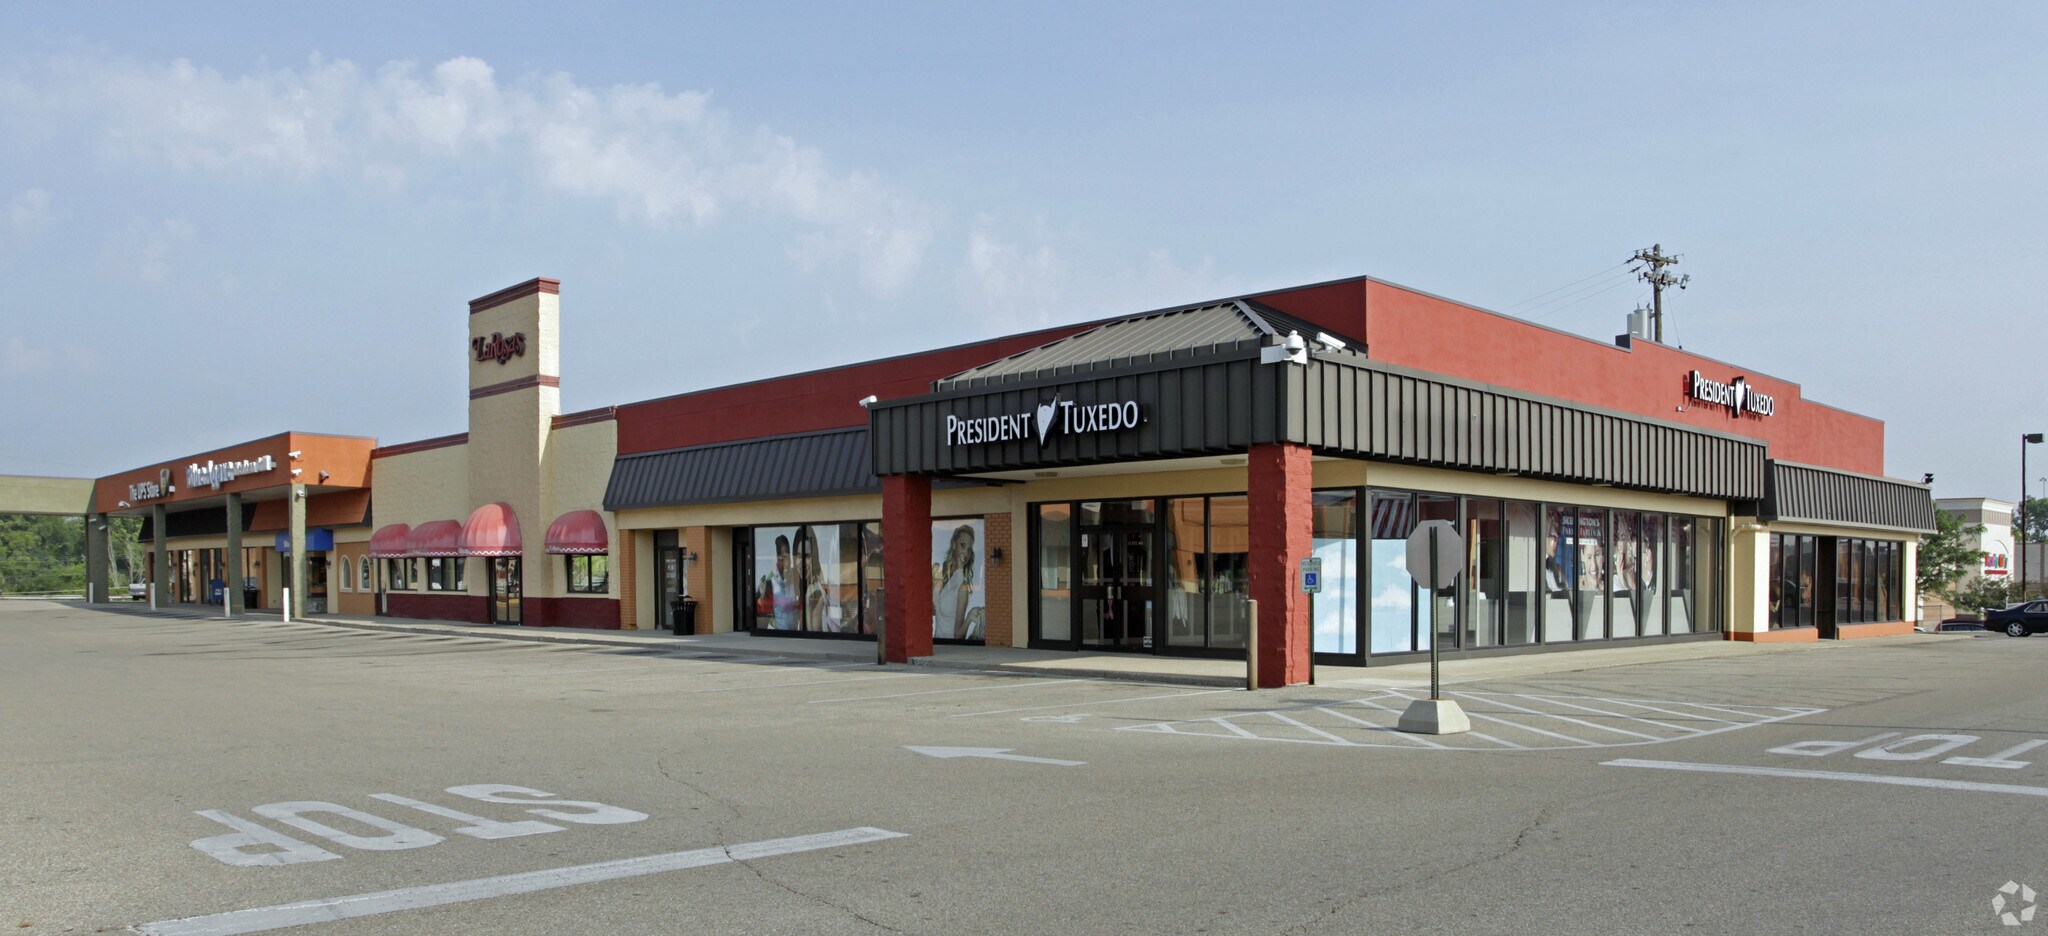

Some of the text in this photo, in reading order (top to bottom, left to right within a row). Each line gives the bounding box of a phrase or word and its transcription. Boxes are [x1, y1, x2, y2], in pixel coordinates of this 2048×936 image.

[1694, 369, 1774, 416] PRESIDENT TUXEDO
[946, 400, 1139, 446] PRESIDENT TUXEDO
[188, 784, 649, 866] STOP
